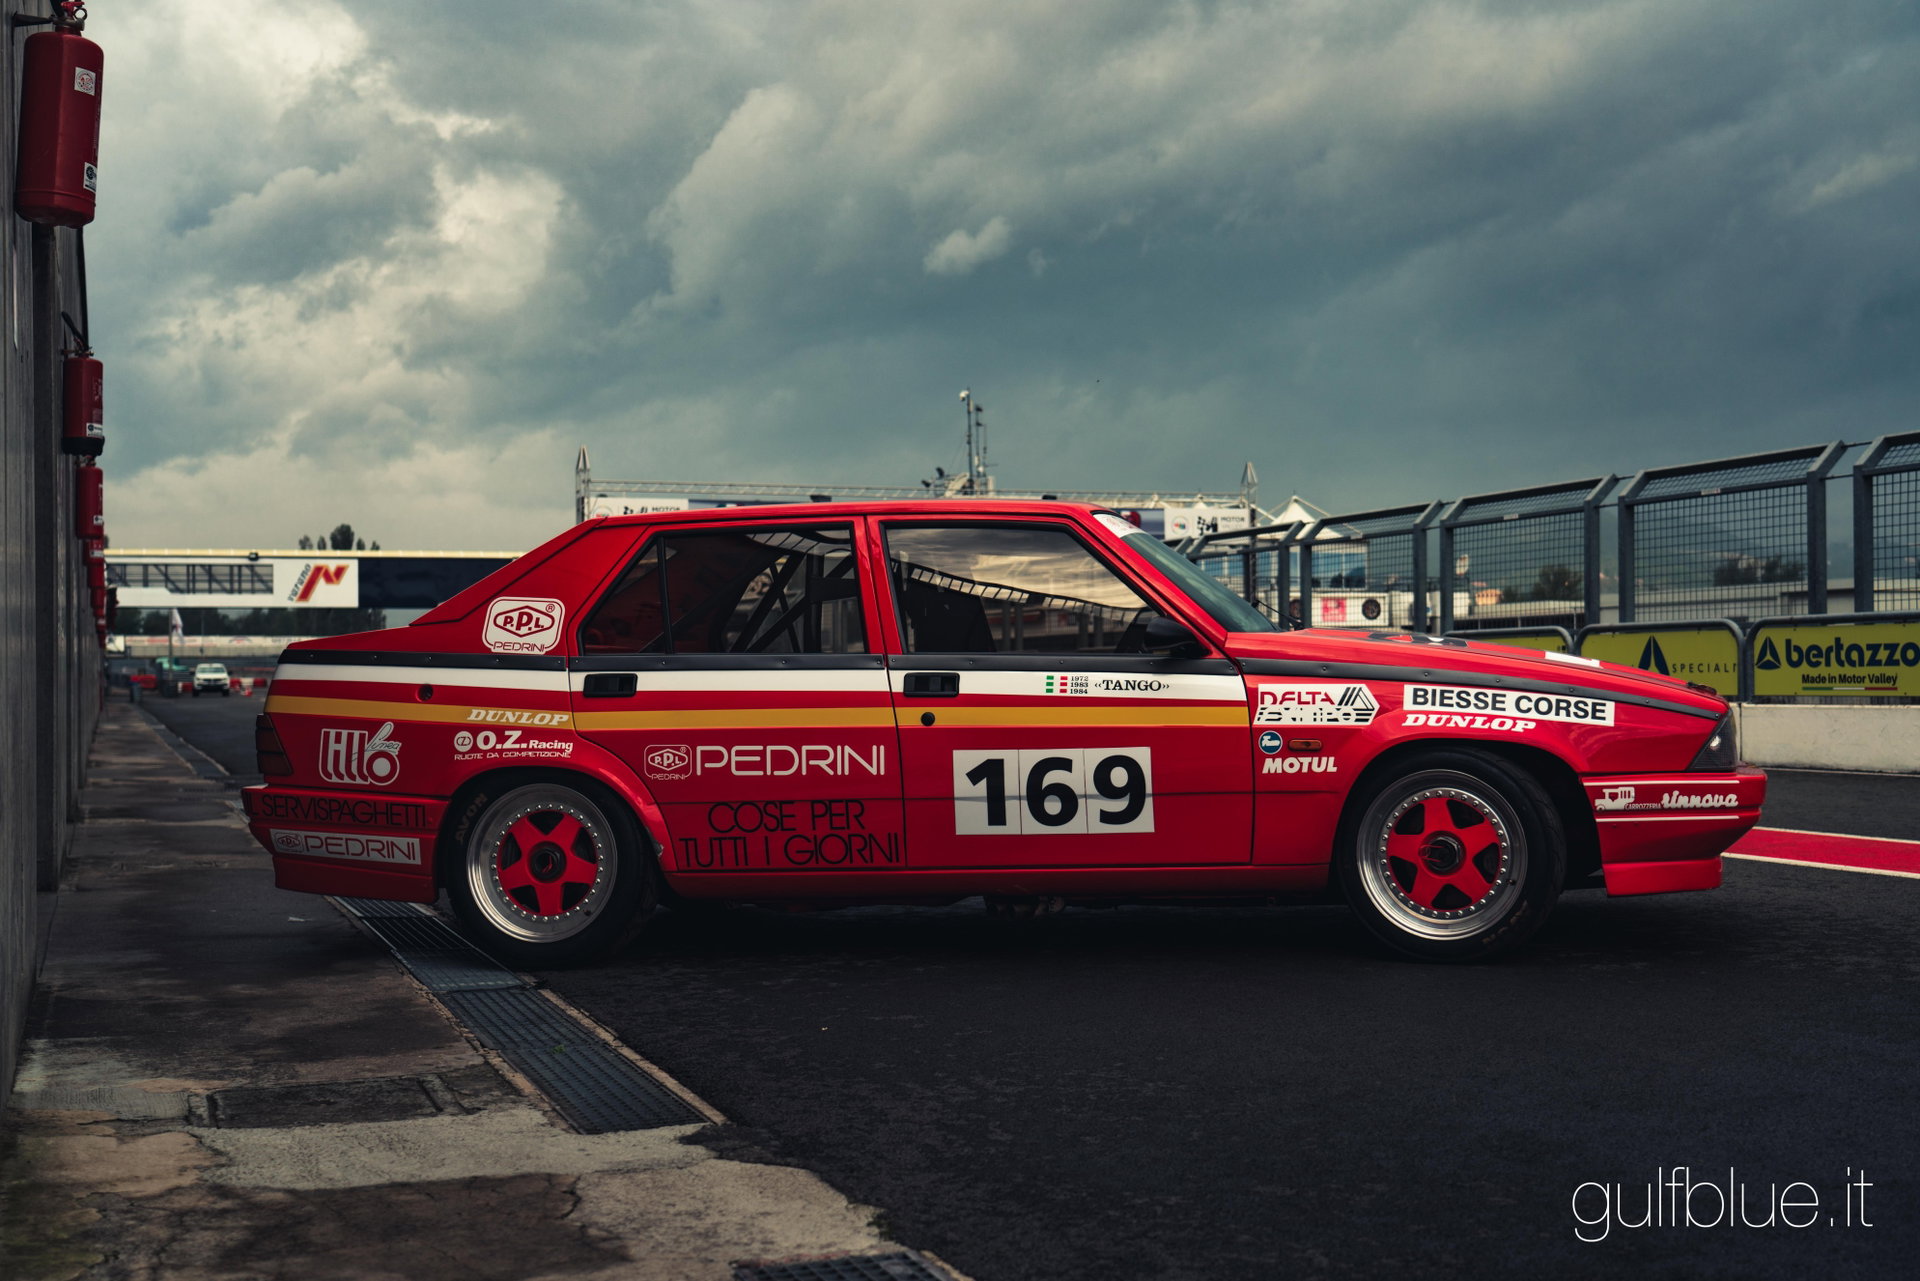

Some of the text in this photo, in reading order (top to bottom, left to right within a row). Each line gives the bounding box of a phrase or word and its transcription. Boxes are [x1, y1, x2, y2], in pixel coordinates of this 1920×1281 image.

[493, 641, 546, 652] PEDRINI
[1785, 637, 1920, 669] bertazzo
[1802, 673, 1898, 686] Made in Motor Valley
[1260, 691, 1336, 705] DELTA
[1412, 688, 1607, 721] BIESSE CORSE
[467, 709, 570, 726] DUNLOP
[1402, 713, 1536, 733] DUNLOP
[529, 740, 573, 753] Racing
[696, 745, 885, 776] PEDRINI
[1262, 757, 1337, 774] MOTUL
[965, 755, 1146, 827] 169
[262, 794, 426, 827] SERVISPAGHETTI
[708, 800, 866, 833] COSE PER
[304, 835, 416, 861] PEDRINI
[678, 832, 900, 868] TUTTI I GIORNI
